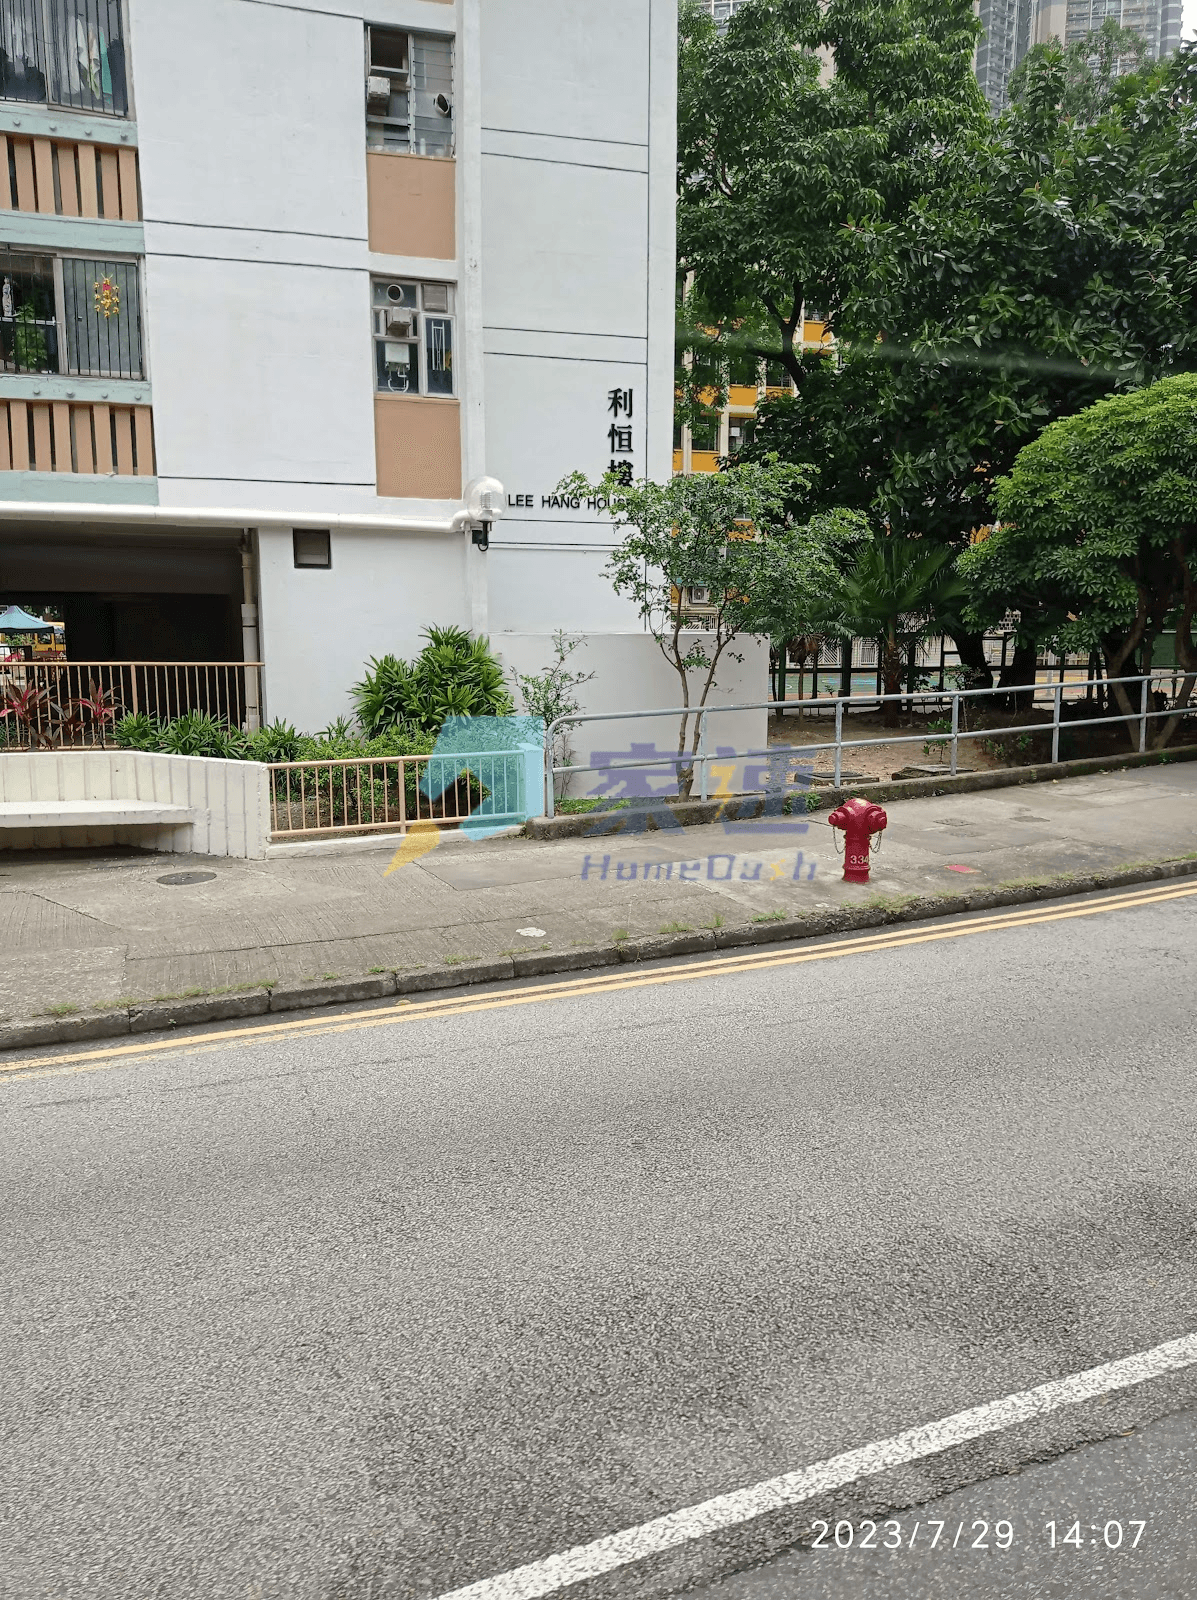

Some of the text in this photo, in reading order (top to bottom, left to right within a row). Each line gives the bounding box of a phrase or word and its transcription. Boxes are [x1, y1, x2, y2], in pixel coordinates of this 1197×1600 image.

[507, 494, 628, 510] LEE HANG HOU
